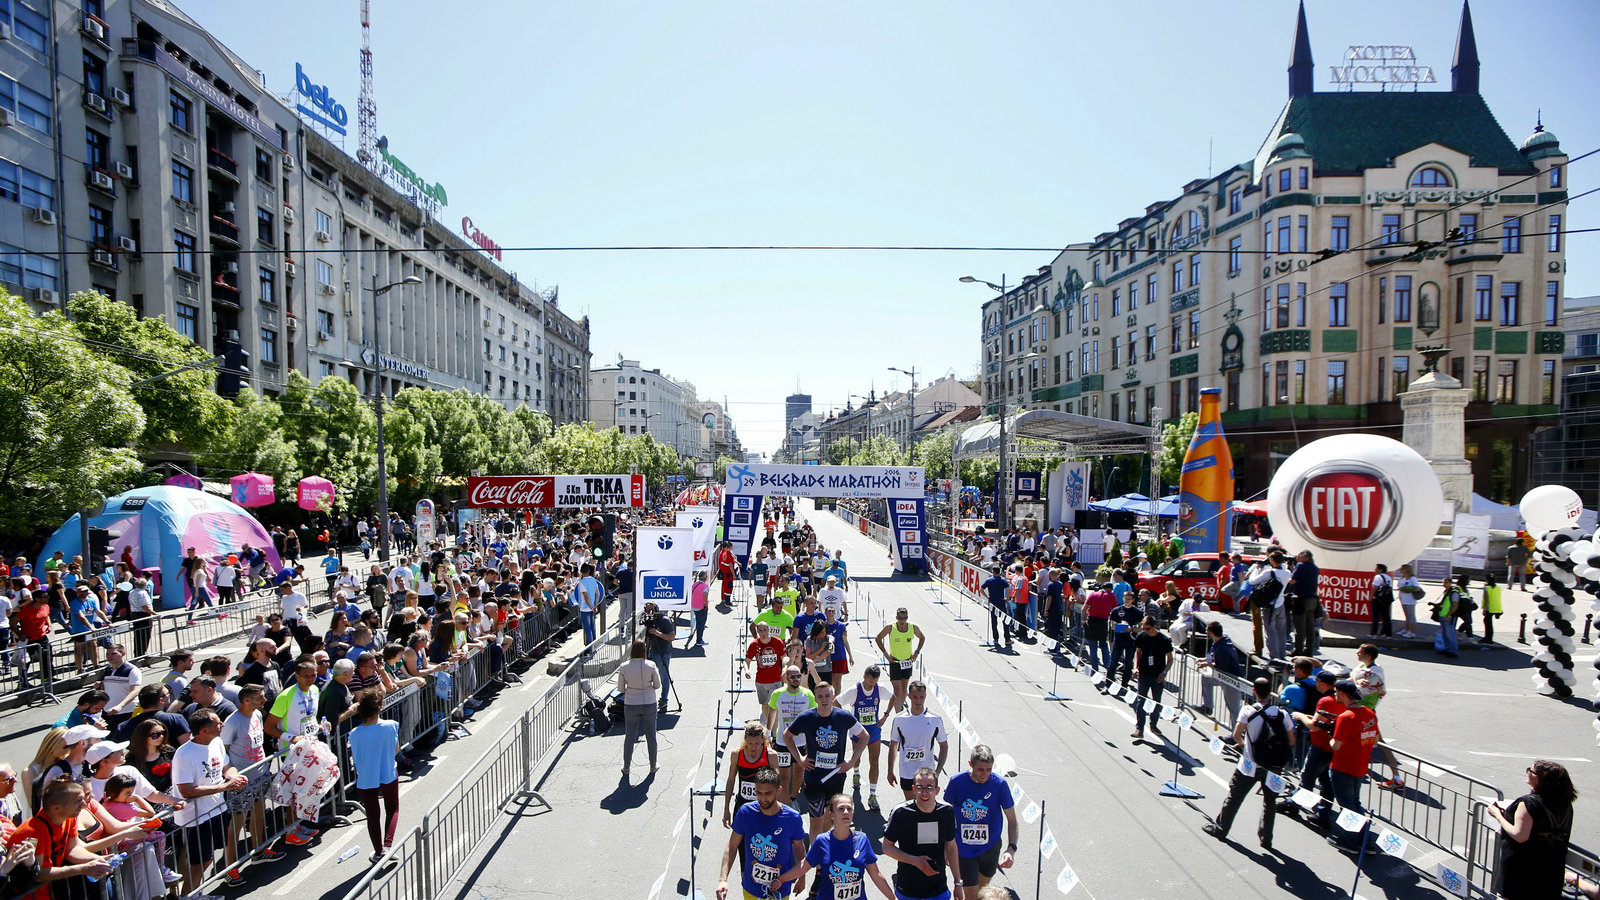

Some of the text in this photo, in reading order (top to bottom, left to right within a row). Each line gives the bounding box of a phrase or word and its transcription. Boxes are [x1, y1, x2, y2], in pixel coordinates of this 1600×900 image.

[1350, 45, 1416, 60] ХОТЕЛ
[1329, 65, 1437, 83] МОСКВА
[184, 68, 262, 133] KASINA HOTEL
[296, 62, 348, 126] beko
[461, 215, 502, 262] Canon
[584, 478, 624, 495] TRKA
[760, 472, 825, 488] BELGRADE
[828, 473, 901, 489] MARATHON
[471, 479, 550, 505] Coca-Cola
[558, 495, 626, 505] ZADOVOLJSTVA
[632, 483, 641, 500] CILJ
[1311, 486, 1376, 529] FIAT
[1317, 575, 1370, 589] PROUDLY
[1317, 586, 1370, 601] MADE IN
[1320, 599, 1369, 616] ERBIA
[385, 690, 405, 704] БЕОГРАД
[858, 706, 877, 714] SERBIA
[962, 829, 987, 841] 4244
[754, 868, 778, 881] 2218
[837, 885, 859, 900] 4714
